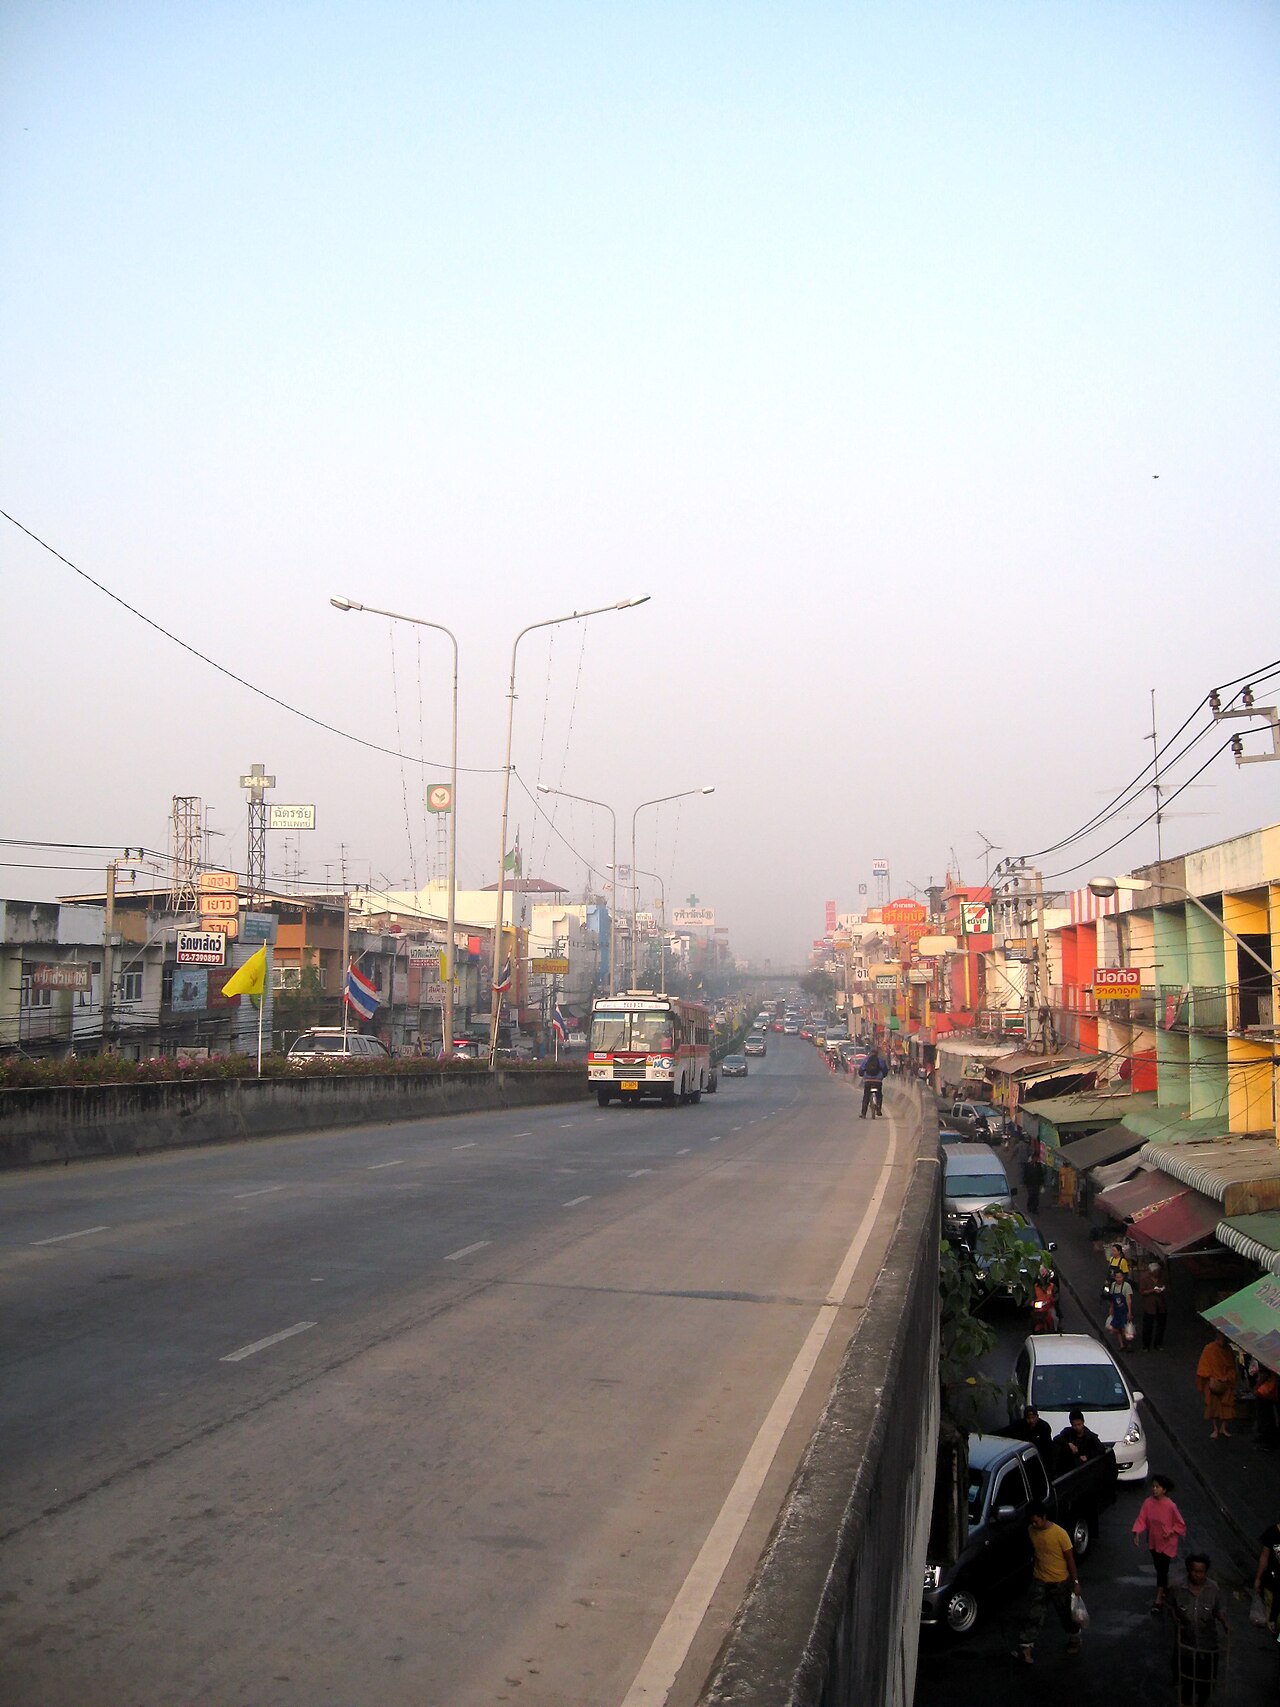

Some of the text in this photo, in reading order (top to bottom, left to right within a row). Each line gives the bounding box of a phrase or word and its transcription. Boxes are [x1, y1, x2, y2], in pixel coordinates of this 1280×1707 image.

[274, 807, 312, 819] ฉัตรชัย
[207, 900, 232, 910] เยาว
[180, 934, 222, 952] รักษาสัตว์
[1096, 969, 1138, 983] มือถือ
[1096, 987, 1138, 998] ราคาถูก
